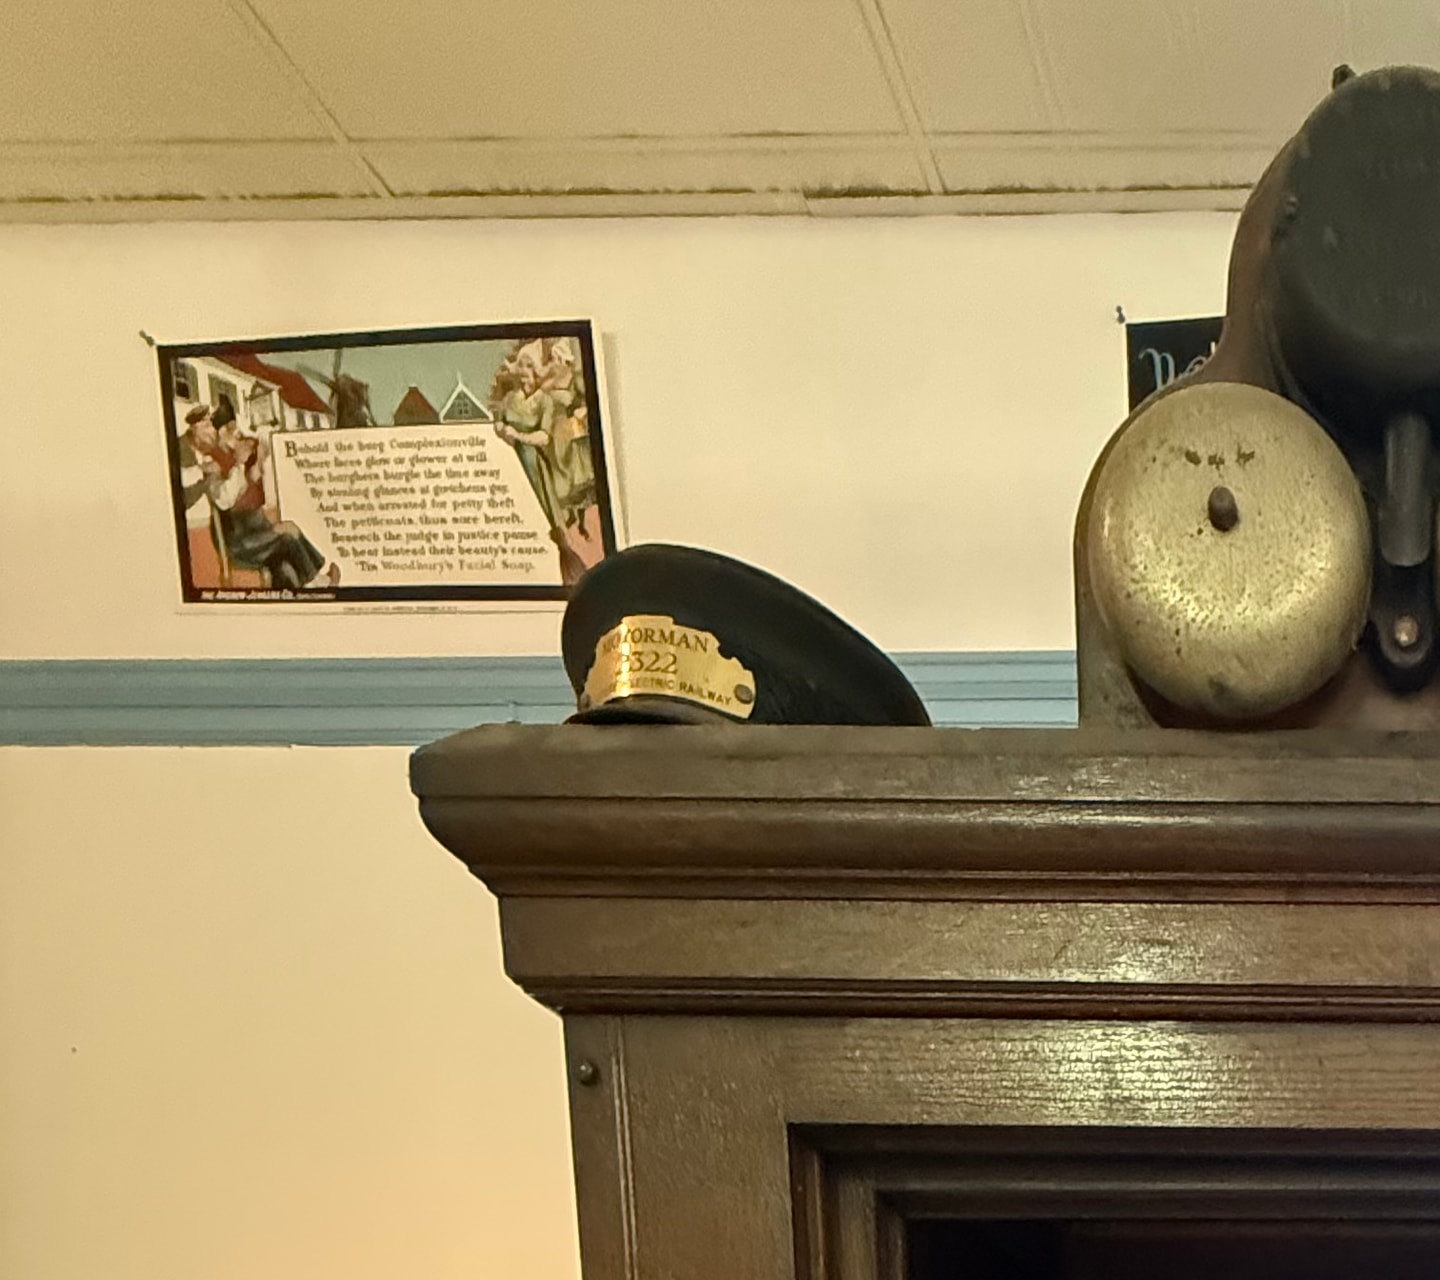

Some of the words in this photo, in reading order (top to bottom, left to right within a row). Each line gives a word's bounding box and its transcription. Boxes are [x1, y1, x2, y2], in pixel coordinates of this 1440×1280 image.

[334, 442, 354, 452] the
[357, 441, 384, 453] burg
[393, 457, 406, 465] or
[466, 451, 487, 463] will
[304, 472, 325, 483] The
[424, 468, 442, 479] the
[445, 468, 470, 480] time
[473, 468, 501, 480] away
[310, 487, 323, 500] By
[318, 502, 338, 512] And
[342, 501, 374, 512] when
[431, 497, 447, 508] for
[324, 516, 346, 528] The
[384, 530, 402, 541] the
[382, 545, 425, 556] instead
[429, 544, 454, 555] their
